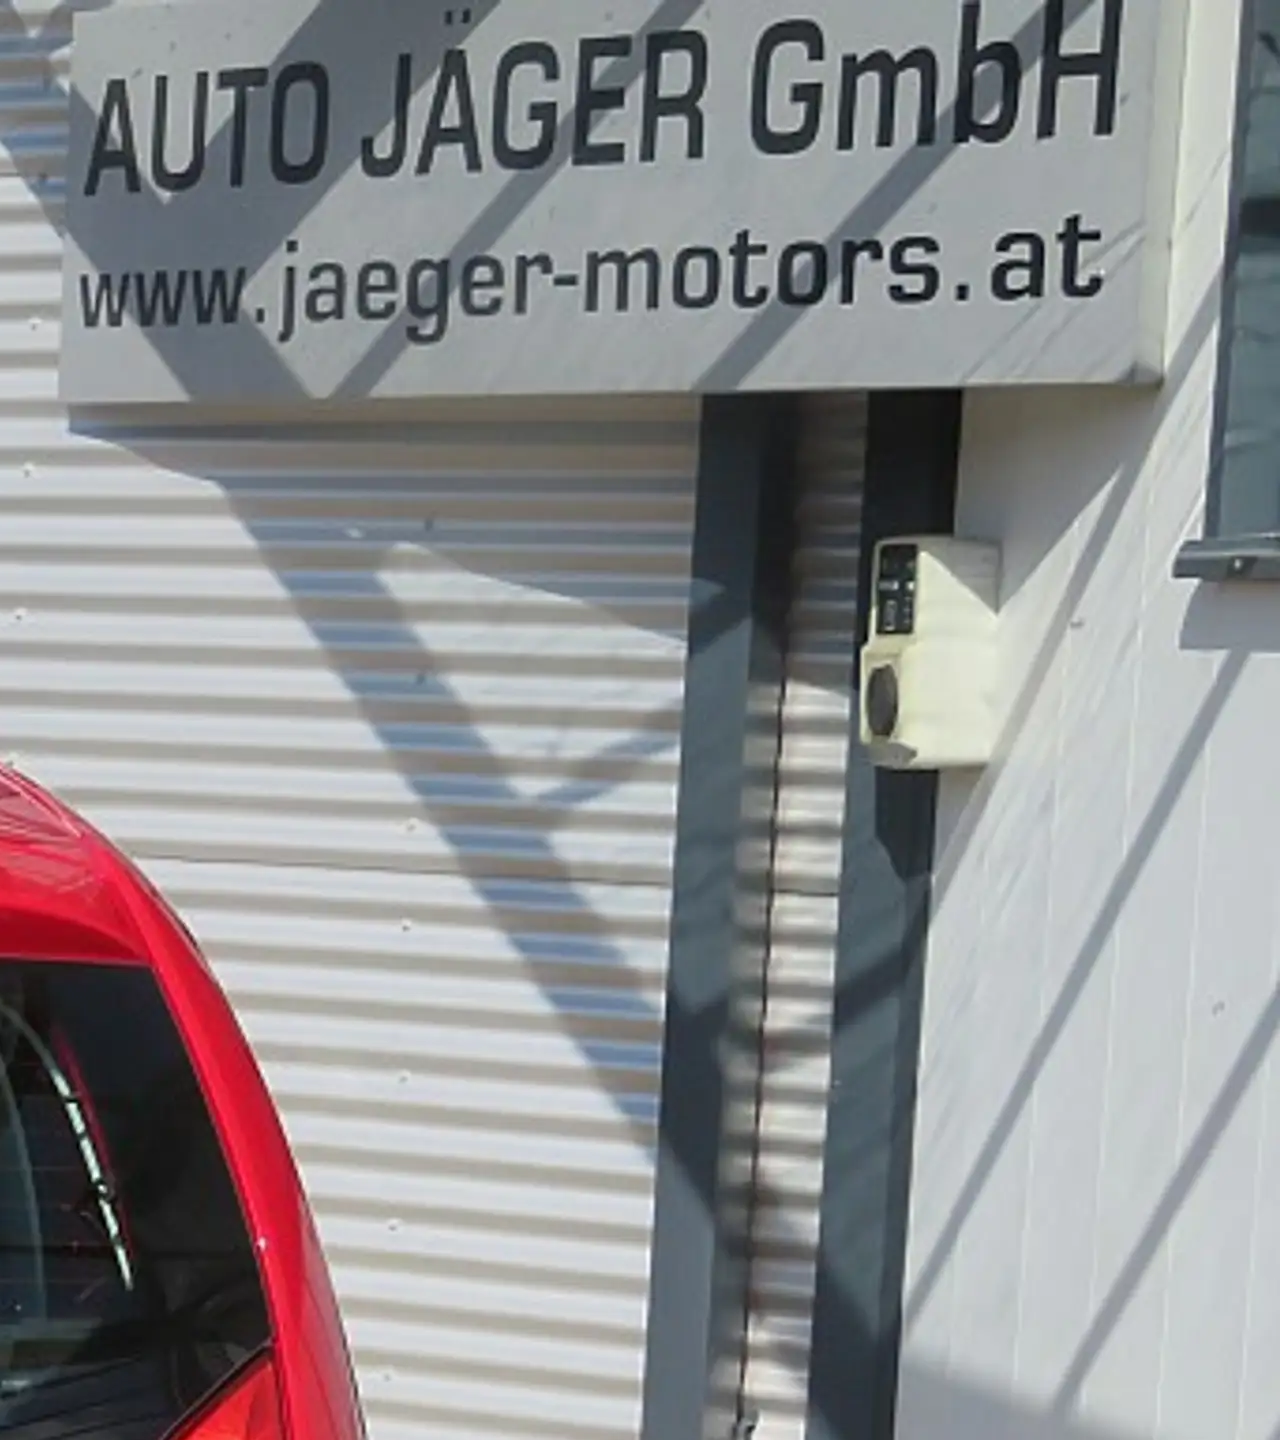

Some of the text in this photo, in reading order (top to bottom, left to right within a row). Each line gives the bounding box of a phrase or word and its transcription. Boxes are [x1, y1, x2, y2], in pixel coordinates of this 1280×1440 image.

[83, 0, 1124, 197] AUTO JÄGER GmbH
[79, 212, 1105, 345] www.jaeger-motors.at
